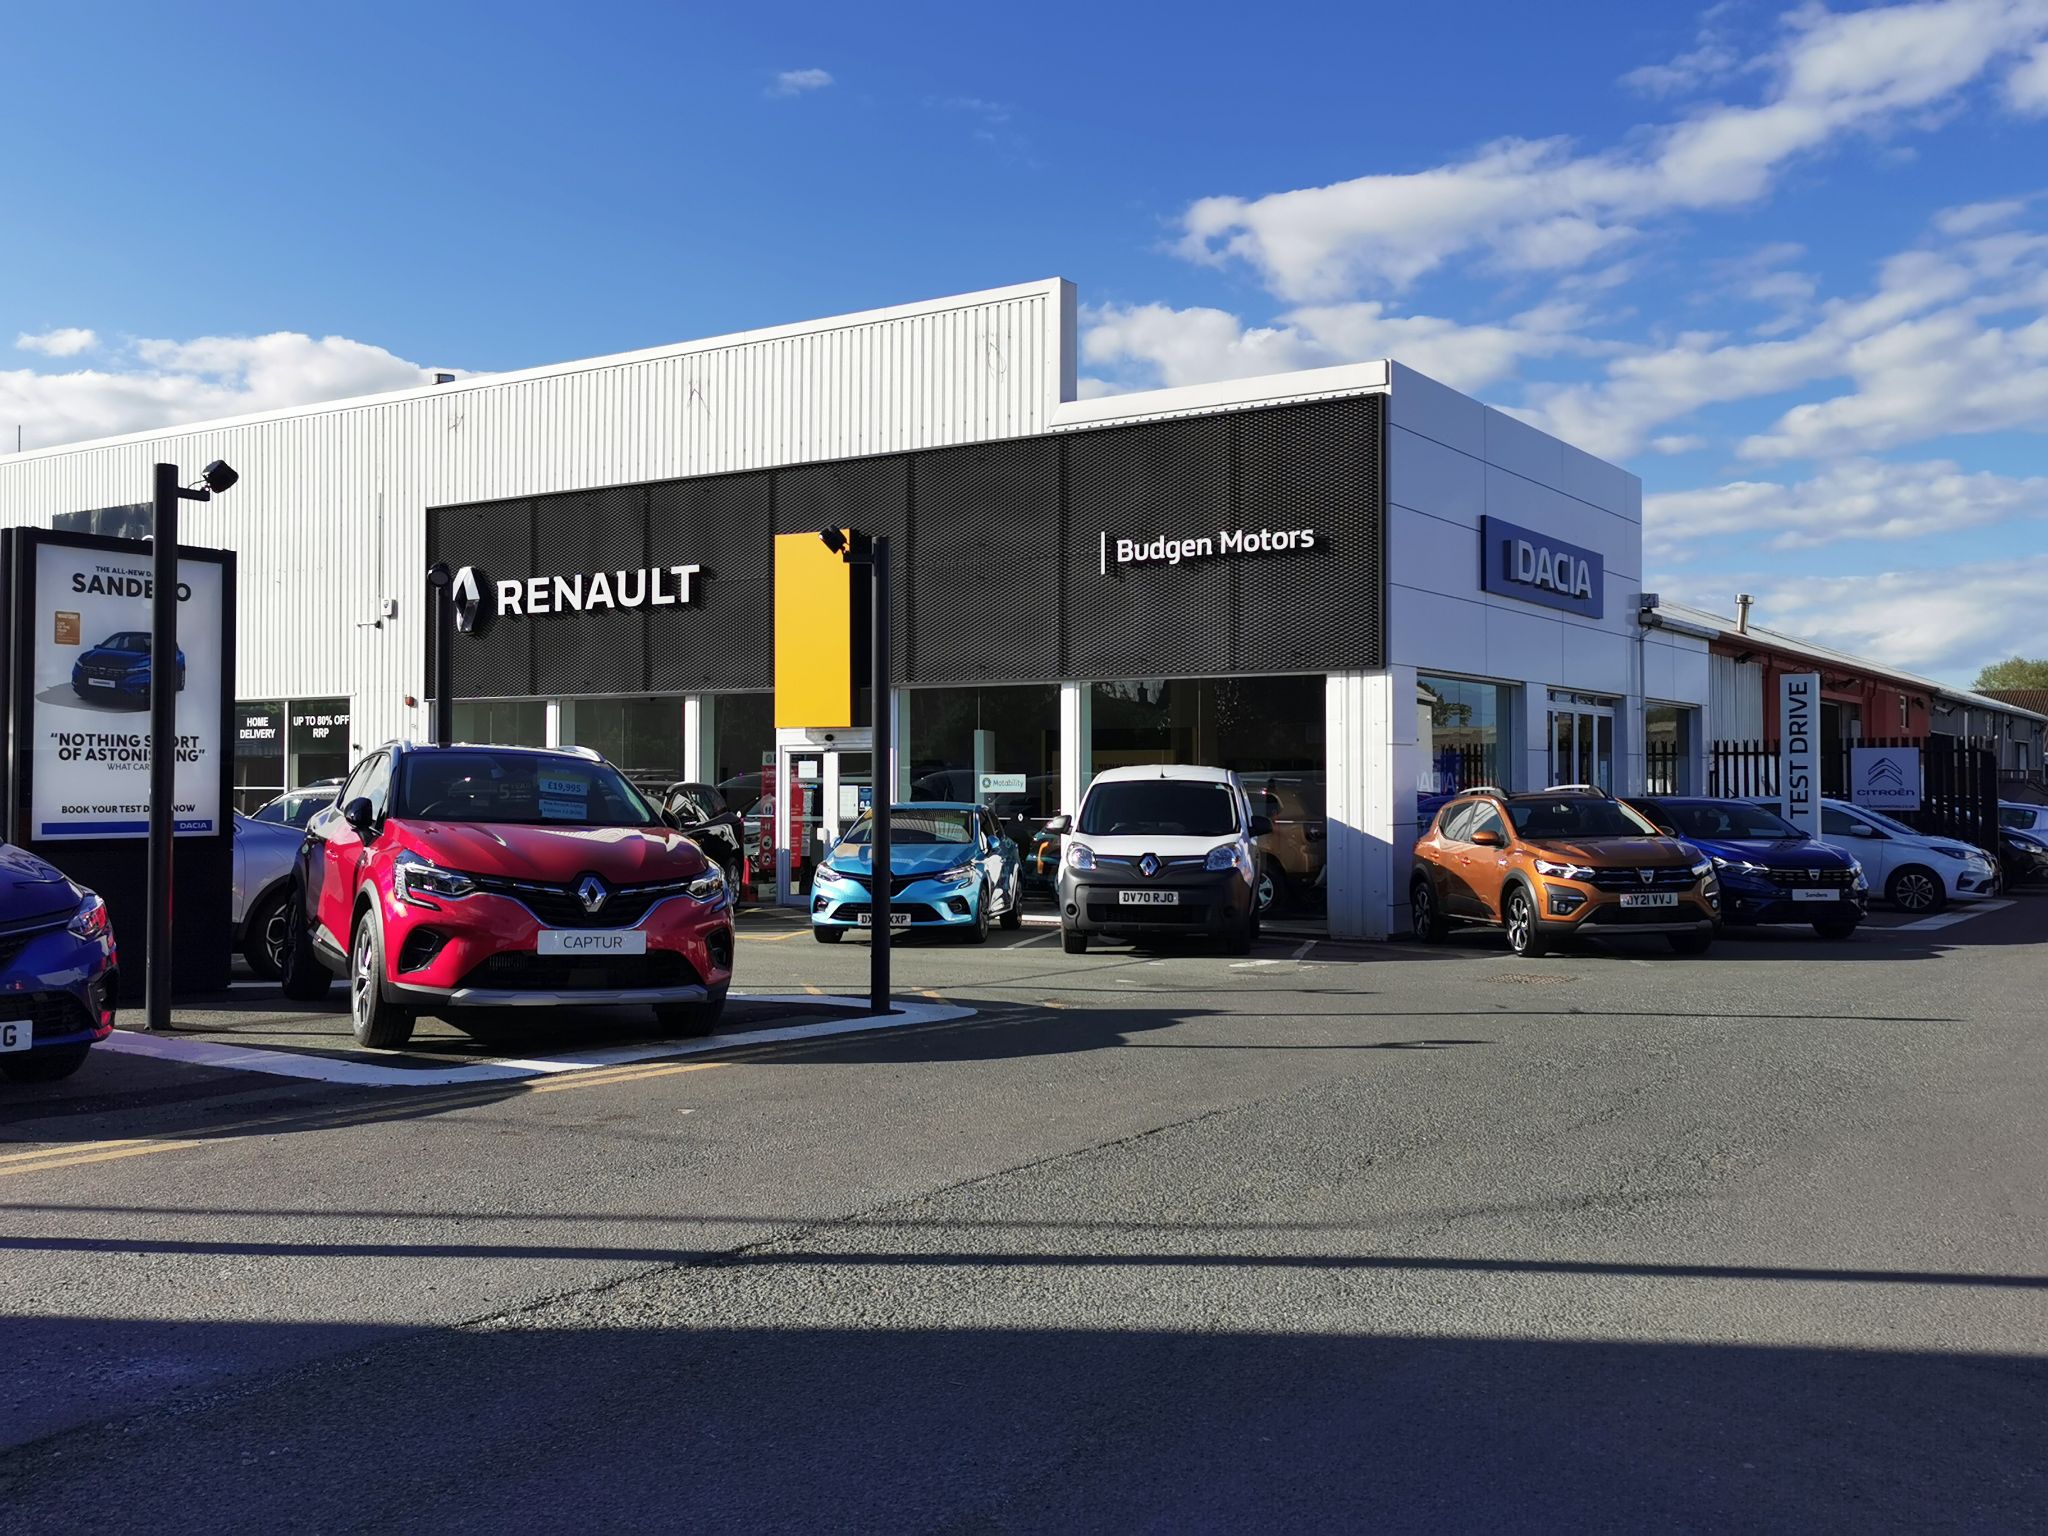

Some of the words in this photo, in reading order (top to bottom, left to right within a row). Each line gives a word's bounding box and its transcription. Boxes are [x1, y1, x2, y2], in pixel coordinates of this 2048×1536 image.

[1116, 534, 1213, 565] Budgen
[1220, 528, 1315, 554] Motors
[96, 565, 110, 574] THE
[111, 567, 145, 577] ALL-NEW
[1518, 539, 1593, 599] DACIA
[72, 572, 192, 602] SANDEO
[497, 564, 700, 616] RENAULT
[246, 717, 269, 727] HOME
[293, 716, 304, 726] UP
[305, 716, 316, 726] TO
[317, 715, 332, 726] 80%
[334, 715, 350, 725] OFF
[1788, 681, 1808, 754] DRIVE
[240, 729, 276, 739] DELIVERY
[312, 728, 330, 738] RRP
[58, 748, 82, 760] OF
[107, 763, 131, 771] WHAT
[548, 781, 581, 793] £19,995
[1789, 760, 1809, 819] TEST
[61, 805, 90, 814] BOOK
[92, 805, 118, 813] YOUR
[119, 804, 142, 813] TEST
[1123, 892, 1150, 903] DV70
[1652, 894, 1672, 905] VVJ
[563, 936, 623, 949] CAPTUR
